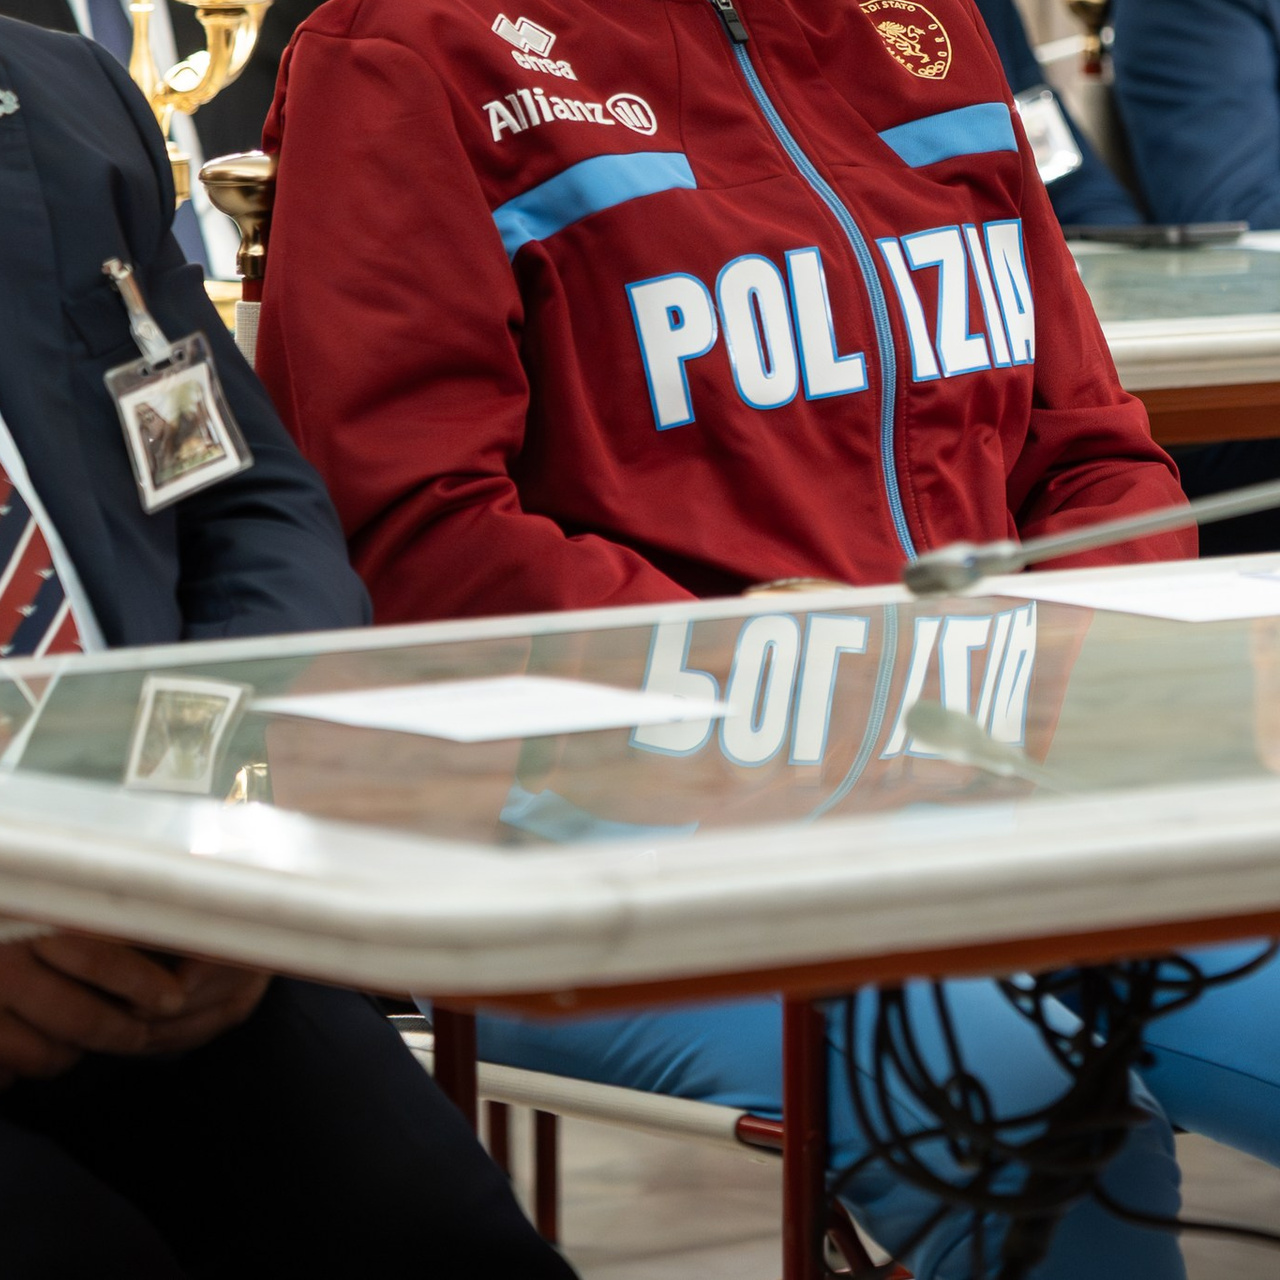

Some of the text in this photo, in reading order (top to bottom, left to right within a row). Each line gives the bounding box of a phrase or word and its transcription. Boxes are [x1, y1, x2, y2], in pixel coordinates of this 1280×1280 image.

[881, 0, 916, 12] STATO
[482, 87, 616, 142] Allianz
[624, 218, 1036, 432] POLIZIA
